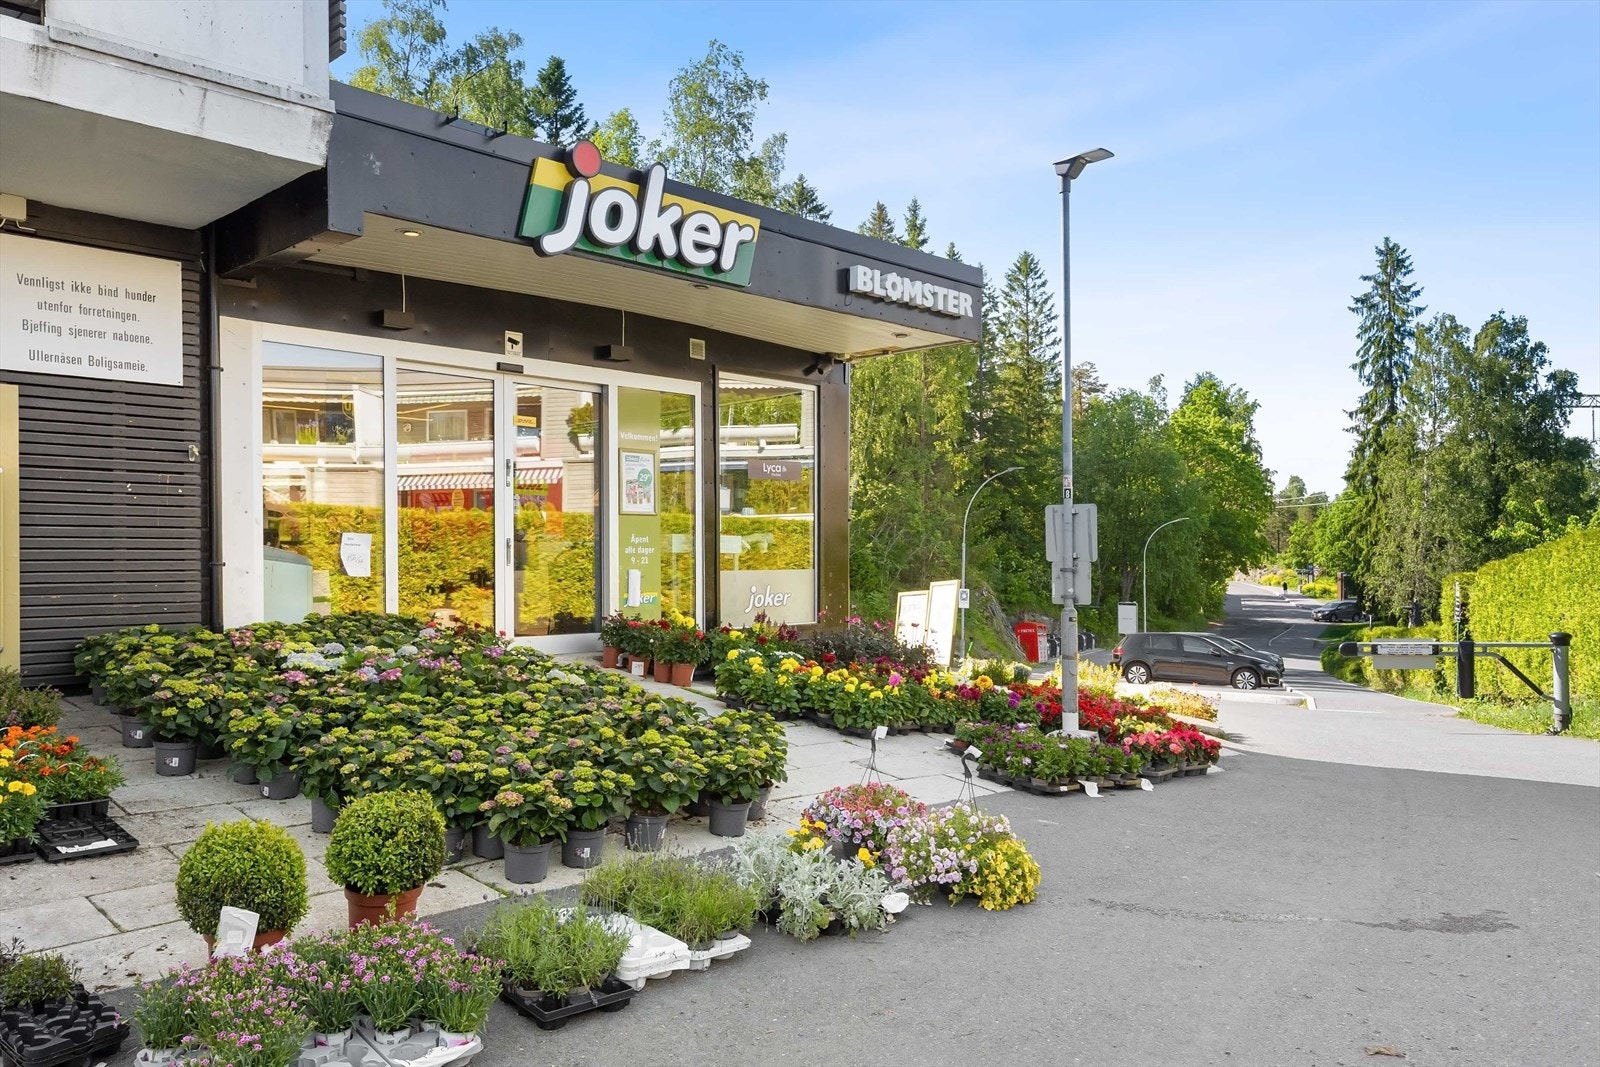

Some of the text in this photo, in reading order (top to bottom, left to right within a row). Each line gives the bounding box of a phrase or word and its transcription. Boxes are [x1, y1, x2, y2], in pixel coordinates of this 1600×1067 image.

[540, 140, 755, 273] joker
[16, 272, 157, 303] Vennligst ikke bind hunder
[850, 264, 974, 318] BLOMSTER
[37, 299, 140, 323] utenfor forretningen.
[22, 318, 153, 345] Bjeffing sjenerer naboene.
[28, 348, 149, 373] Ullernåsen Boligsameie.
[620, 431, 658, 442] Velkommen!
[763, 462, 781, 474] Lyca
[1065, 489, 1070, 498] 8
[624, 546, 655, 555] alle dager
[630, 533, 649, 544] Åpent
[744, 584, 791, 614] joker
